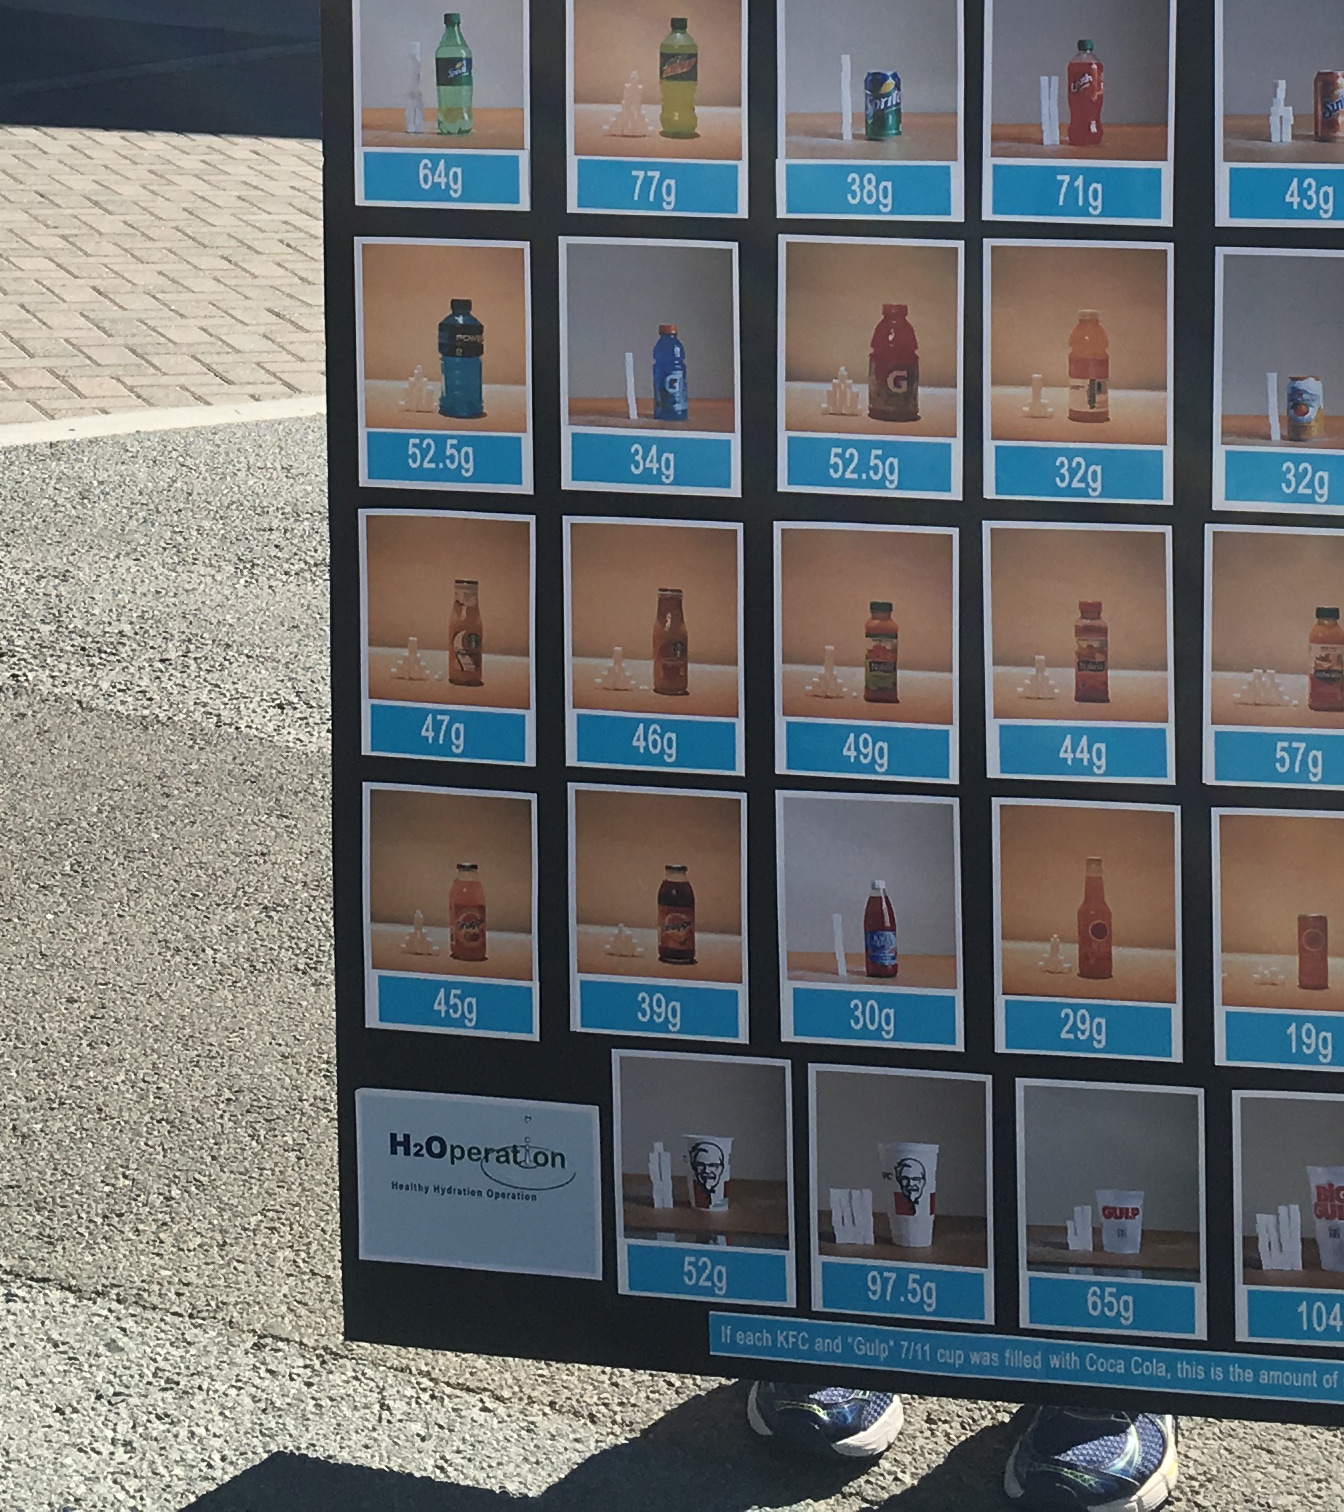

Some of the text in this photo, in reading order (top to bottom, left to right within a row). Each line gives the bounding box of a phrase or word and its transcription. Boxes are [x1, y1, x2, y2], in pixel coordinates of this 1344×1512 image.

[419, 159, 462, 198] 64g
[631, 170, 676, 210] 77g
[847, 173, 893, 212] 38g
[1056, 175, 1103, 215] 71g
[1285, 178, 1335, 219] 43g
[886, 370, 908, 394] G
[407, 438, 473, 477] 52.5g
[630, 443, 675, 483] 34g
[829, 447, 899, 488] 52.5g
[1055, 457, 1102, 497] 32g
[1281, 462, 1329, 503] 32g
[421, 713, 464, 754] 47g
[632, 723, 677, 762] 46g
[842, 733, 889, 773] 49g
[1059, 735, 1106, 775] 44g
[1275, 742, 1323, 782] 57g
[434, 988, 477, 1027] 45g
[637, 992, 681, 1032] 39g
[850, 999, 895, 1039] 30g
[1060, 1009, 1107, 1049] 29g
[1286, 1022, 1333, 1064] 19g
[391, 1181, 537, 1202] Healthy Hydration Operation
[1102, 1205, 1140, 1220] GULP
[683, 1256, 727, 1295] 52g
[867, 1271, 937, 1312] 97.5g
[1087, 1287, 1135, 1325] 65g
[721, 1325, 731, 1344] If
[736, 1330, 772, 1347] each
[777, 1331, 809, 1350] KFC
[814, 1335, 842, 1353] and
[847, 1336, 894, 1360] "Gulp"
[900, 1341, 930, 1362] 7/11
[937, 1348, 964, 1368] cup
[969, 1351, 999, 1367] was
[1005, 1349, 1042, 1369] filled
[1049, 1352, 1080, 1370] with
[1085, 1353, 1125, 1374] Coca
[1131, 1357, 1171, 1379] Cola,
[1176, 1361, 1205, 1379] this
[1210, 1362, 1224, 1381] is
[1229, 1364, 1254, 1382] the
[1259, 1369, 1318, 1388] amount
[1323, 1371, 1338, 1389] of
